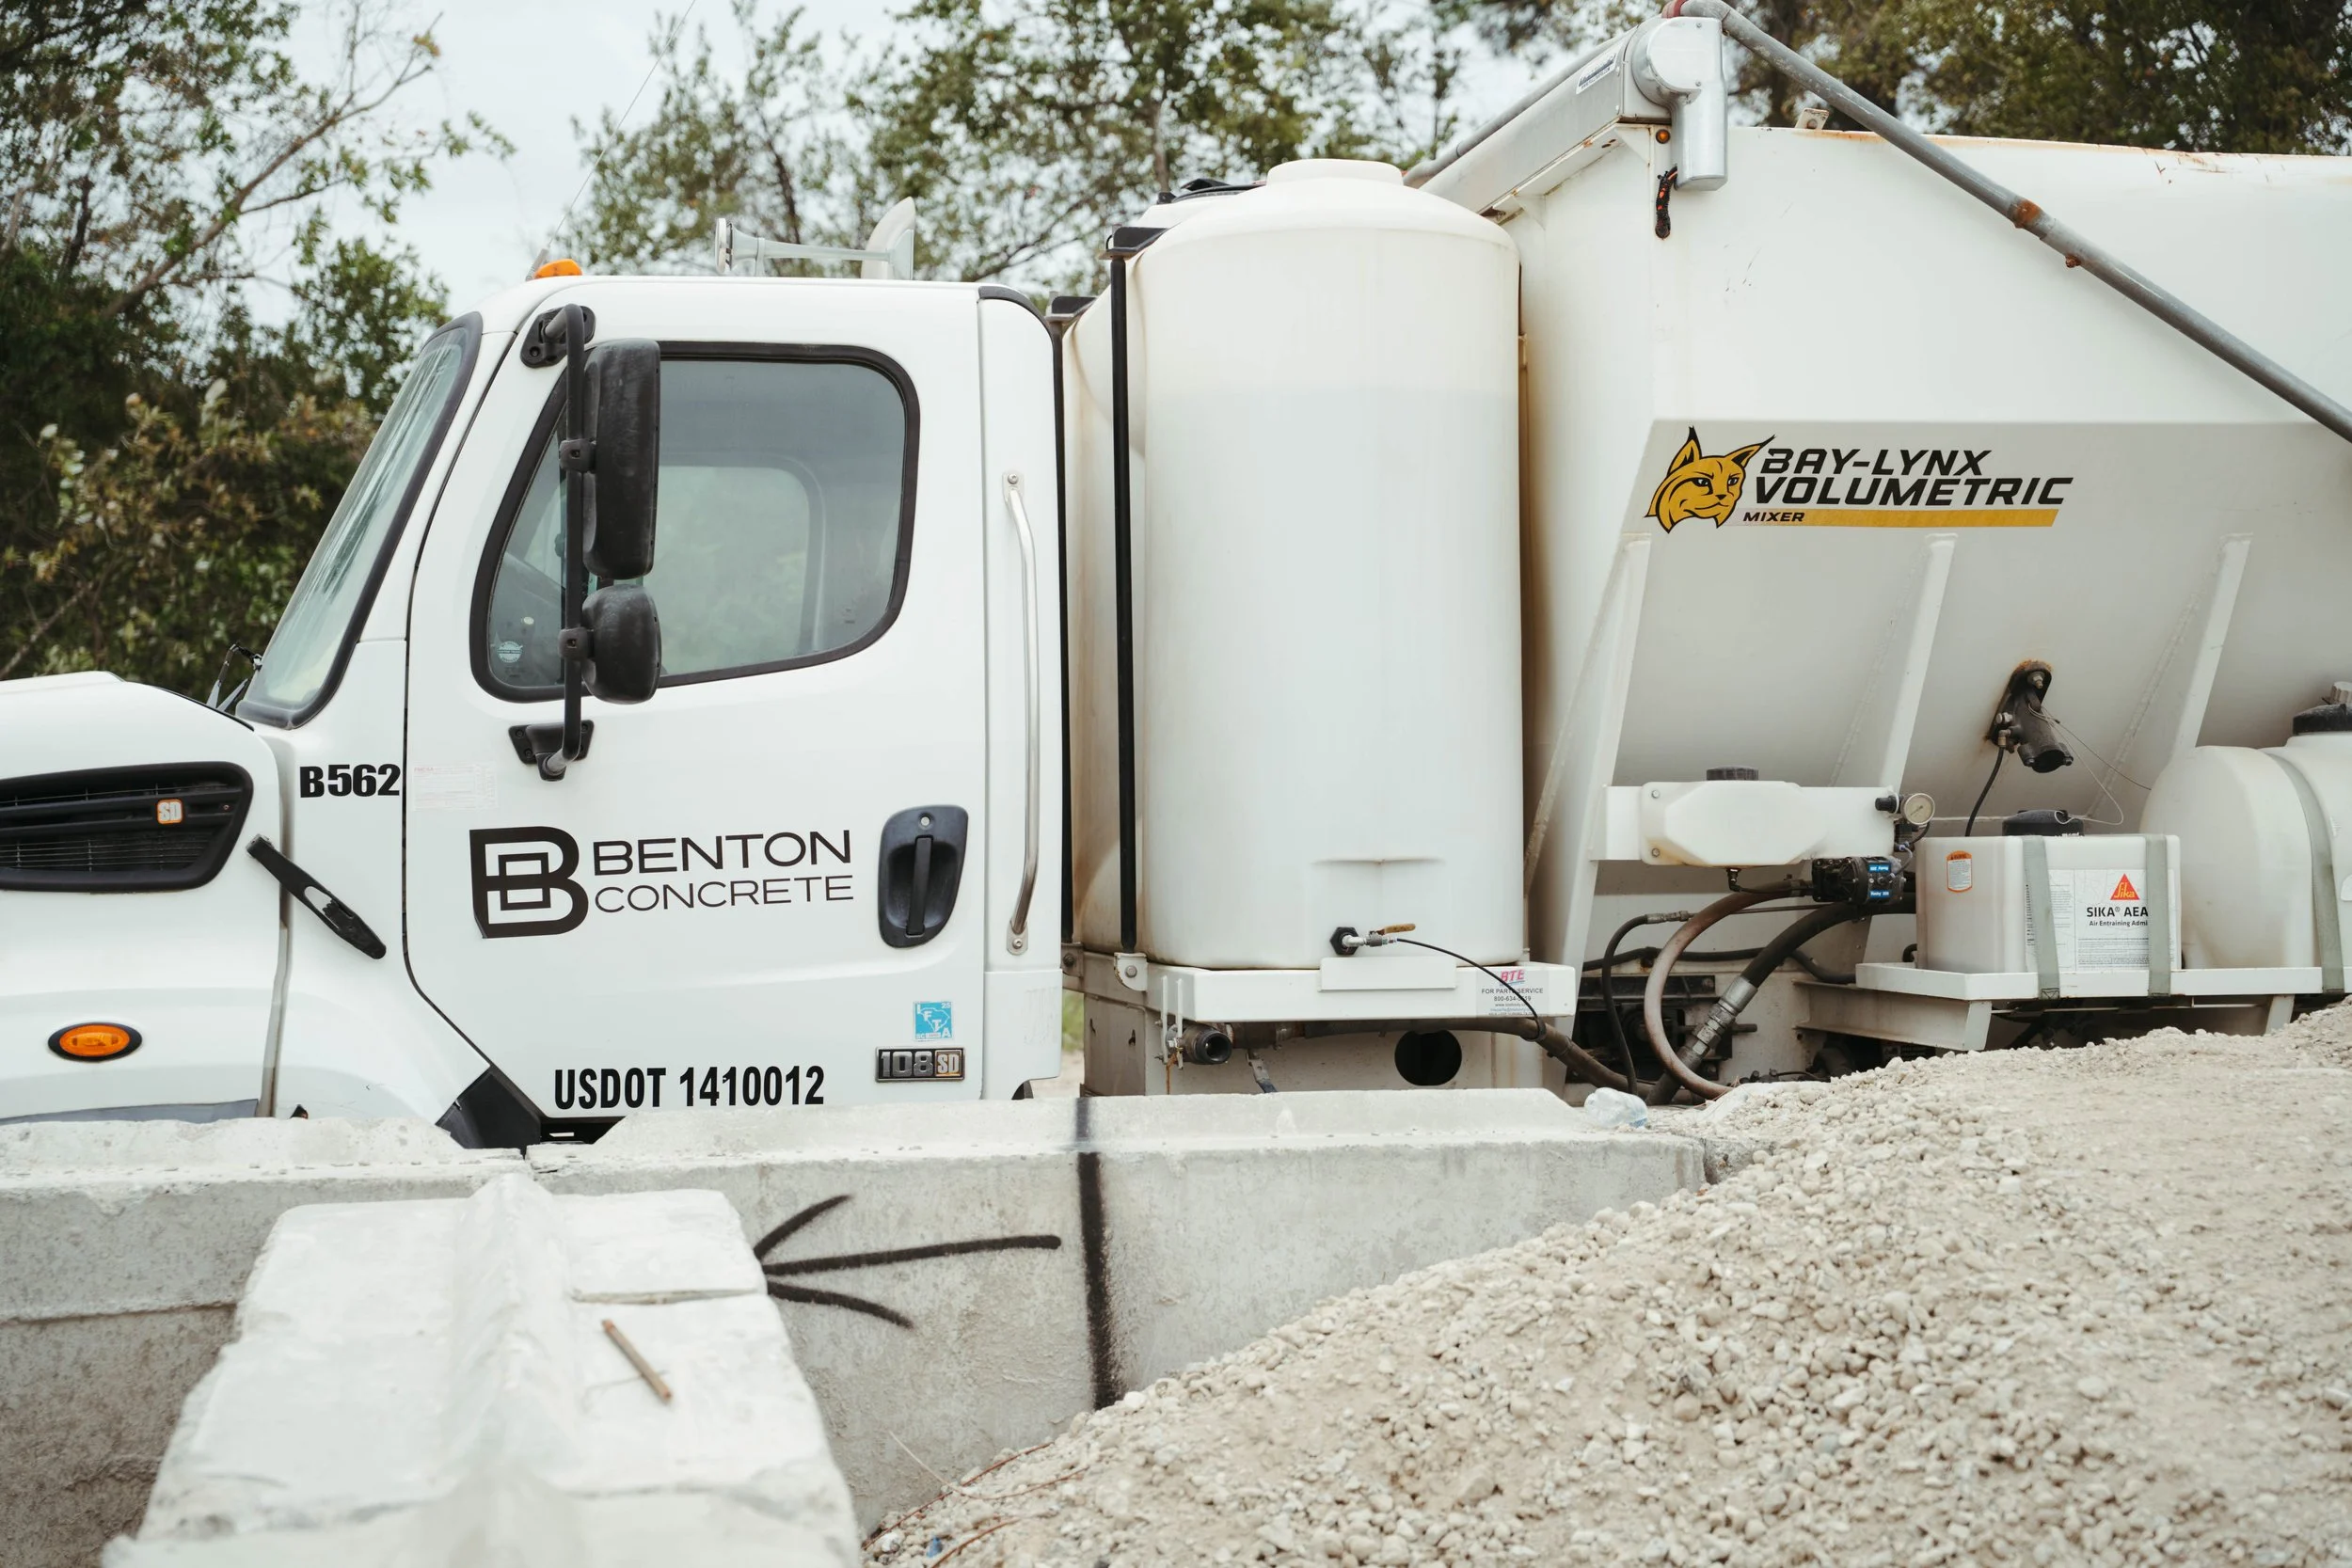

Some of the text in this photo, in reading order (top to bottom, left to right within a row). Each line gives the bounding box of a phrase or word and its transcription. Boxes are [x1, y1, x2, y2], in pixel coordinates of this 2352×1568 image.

[1760, 448, 1992, 476] BAY-LYNX
[1756, 477, 2074, 506] VOLUMETRIC
[1743, 512, 1805, 523] MIXER
[300, 763, 401, 798] B562
[158, 801, 183, 821] SD
[593, 830, 851, 876] BENTON
[595, 875, 854, 912] CONCRETE
[2115, 882, 2137, 898] Sika
[2123, 906, 2149, 917] AEA
[881, 1051, 960, 1078] 108 SD
[555, 1065, 825, 1110] USDOT 1410012
